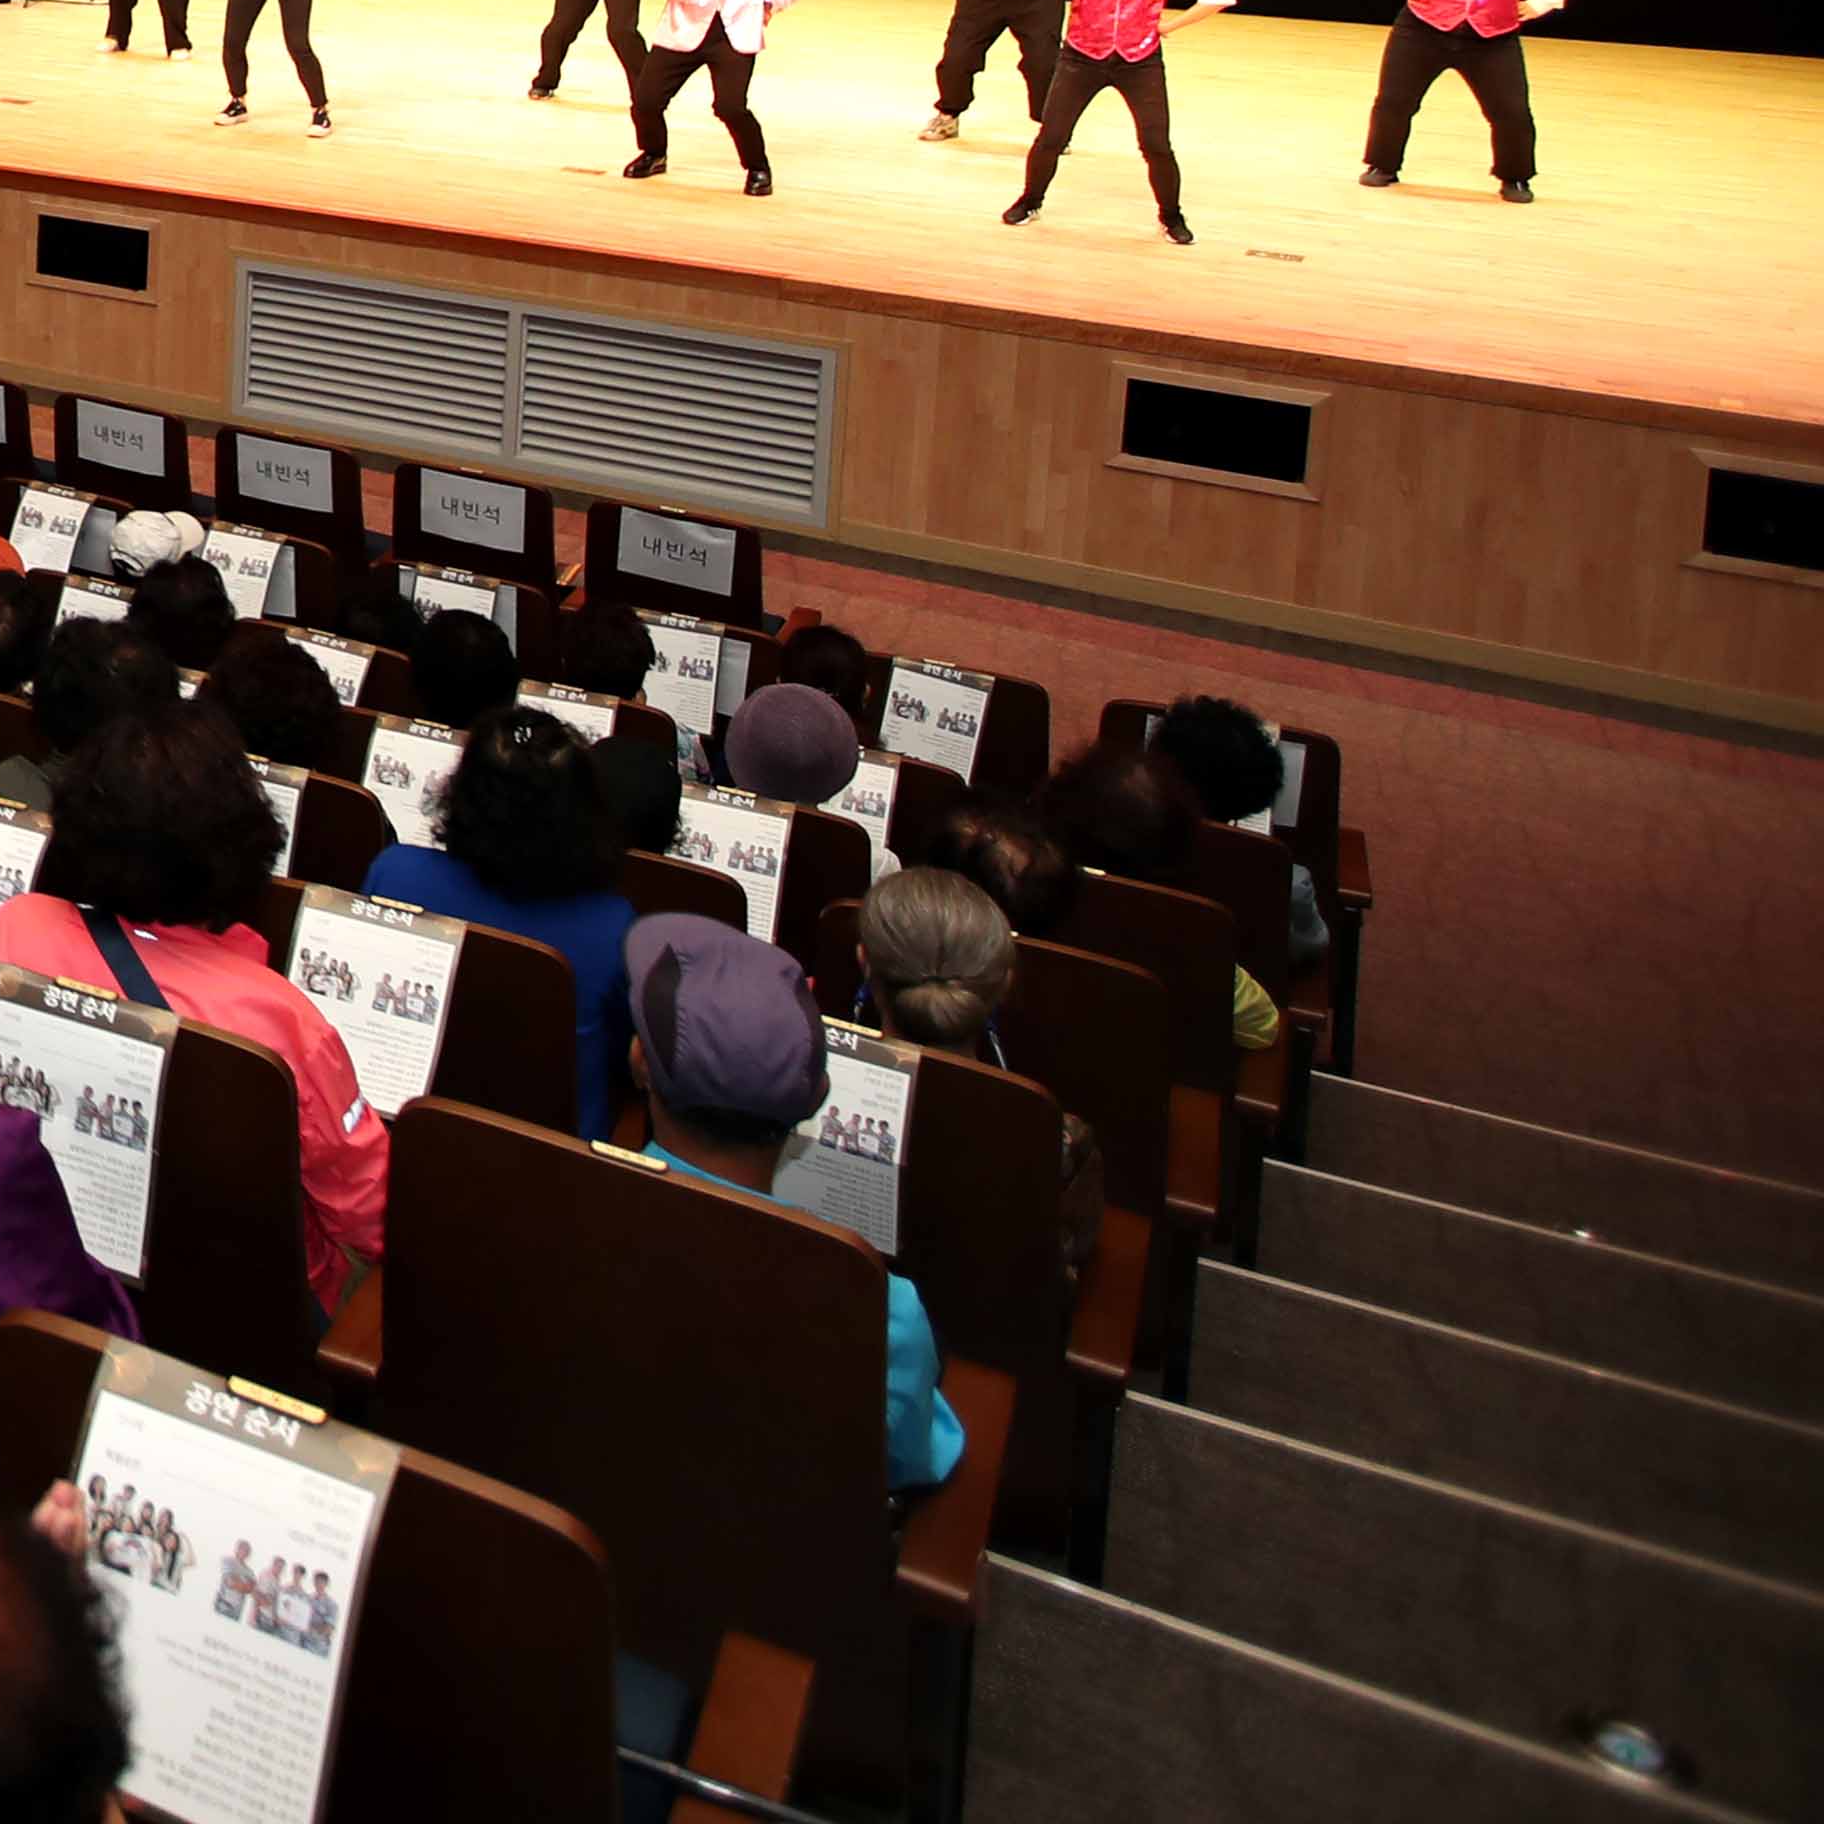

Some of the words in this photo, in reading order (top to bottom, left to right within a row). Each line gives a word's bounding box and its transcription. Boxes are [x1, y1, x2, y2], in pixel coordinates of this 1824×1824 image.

[94, 424, 144, 451] 내빈석
[255, 458, 311, 487] 내빈석
[441, 495, 501, 525] 내빈석
[642, 535, 707, 567] 내빈석
[350, 898, 383, 919] 공연
[383, 906, 414, 927] 순서
[43, 982, 80, 1014] 공연
[80, 995, 118, 1025] 순서
[184, 1381, 241, 1425] 공연
[242, 1404, 303, 1449] 순서
